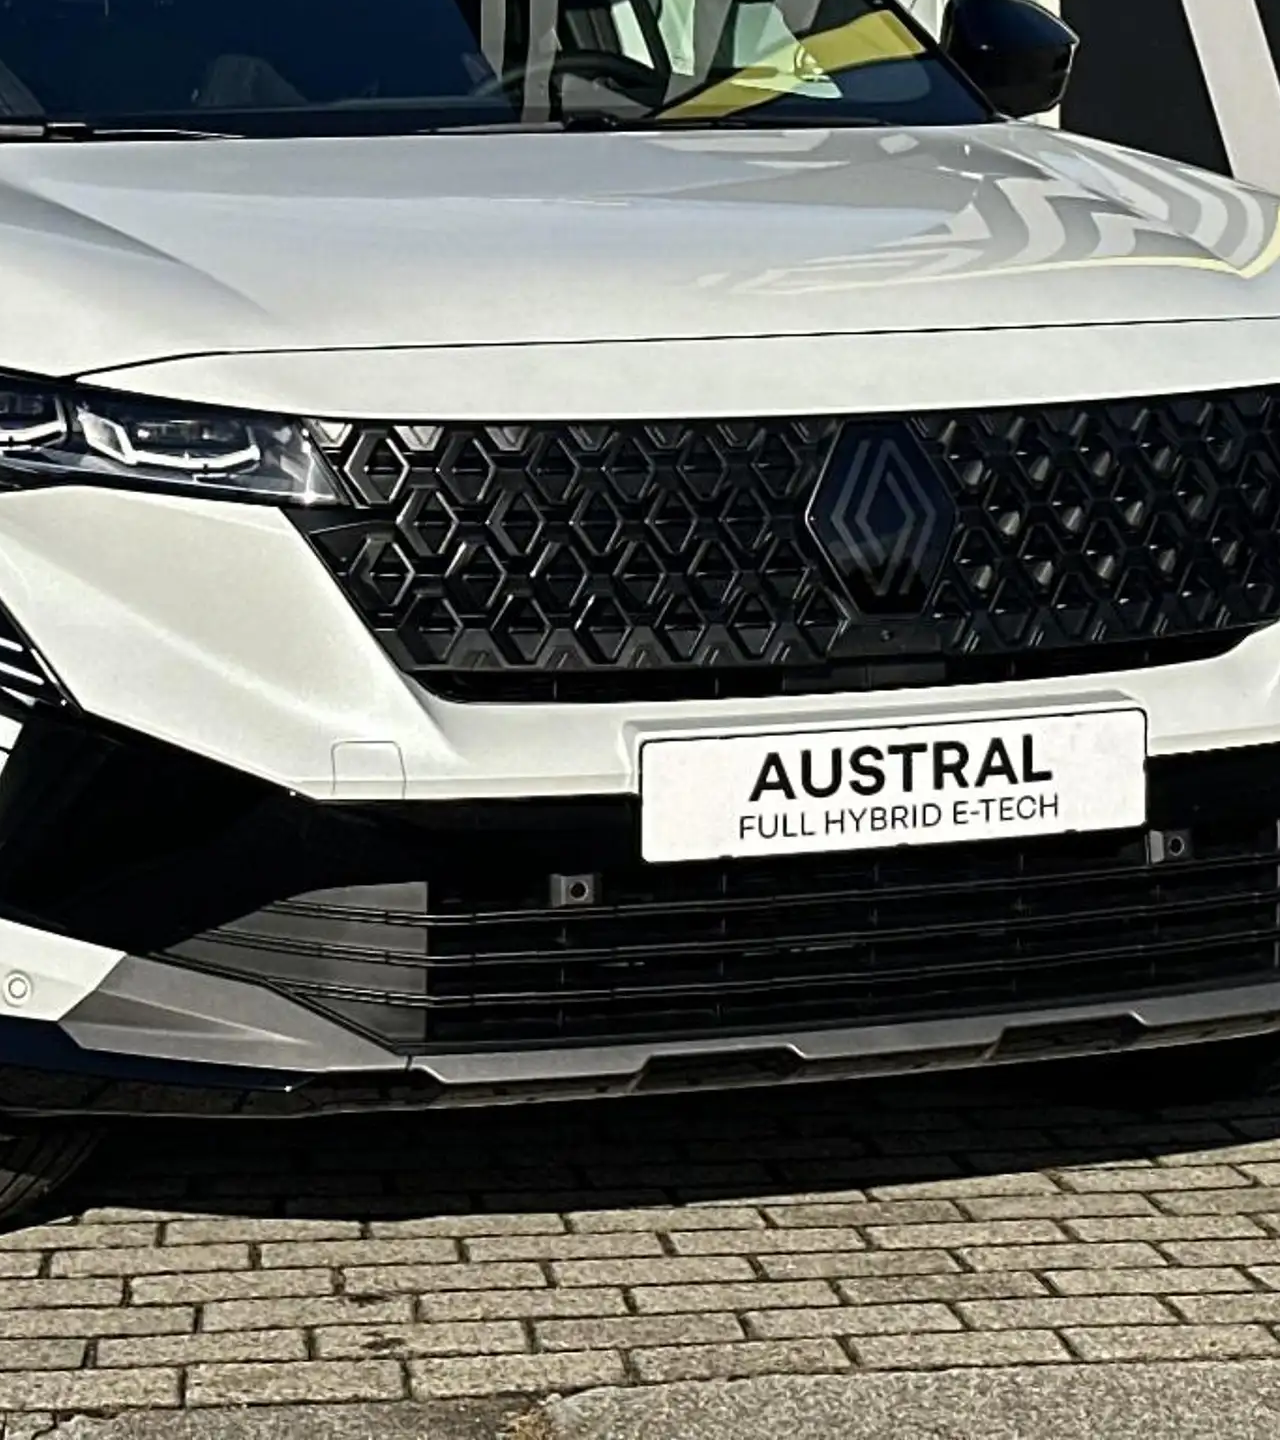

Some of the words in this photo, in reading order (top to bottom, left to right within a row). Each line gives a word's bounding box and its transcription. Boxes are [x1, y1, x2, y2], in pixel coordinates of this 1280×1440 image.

[748, 734, 1053, 801] AUSTRAL
[738, 811, 816, 840] FULL
[824, 803, 942, 835] HYBRID
[952, 792, 1059, 826] E-TECH
